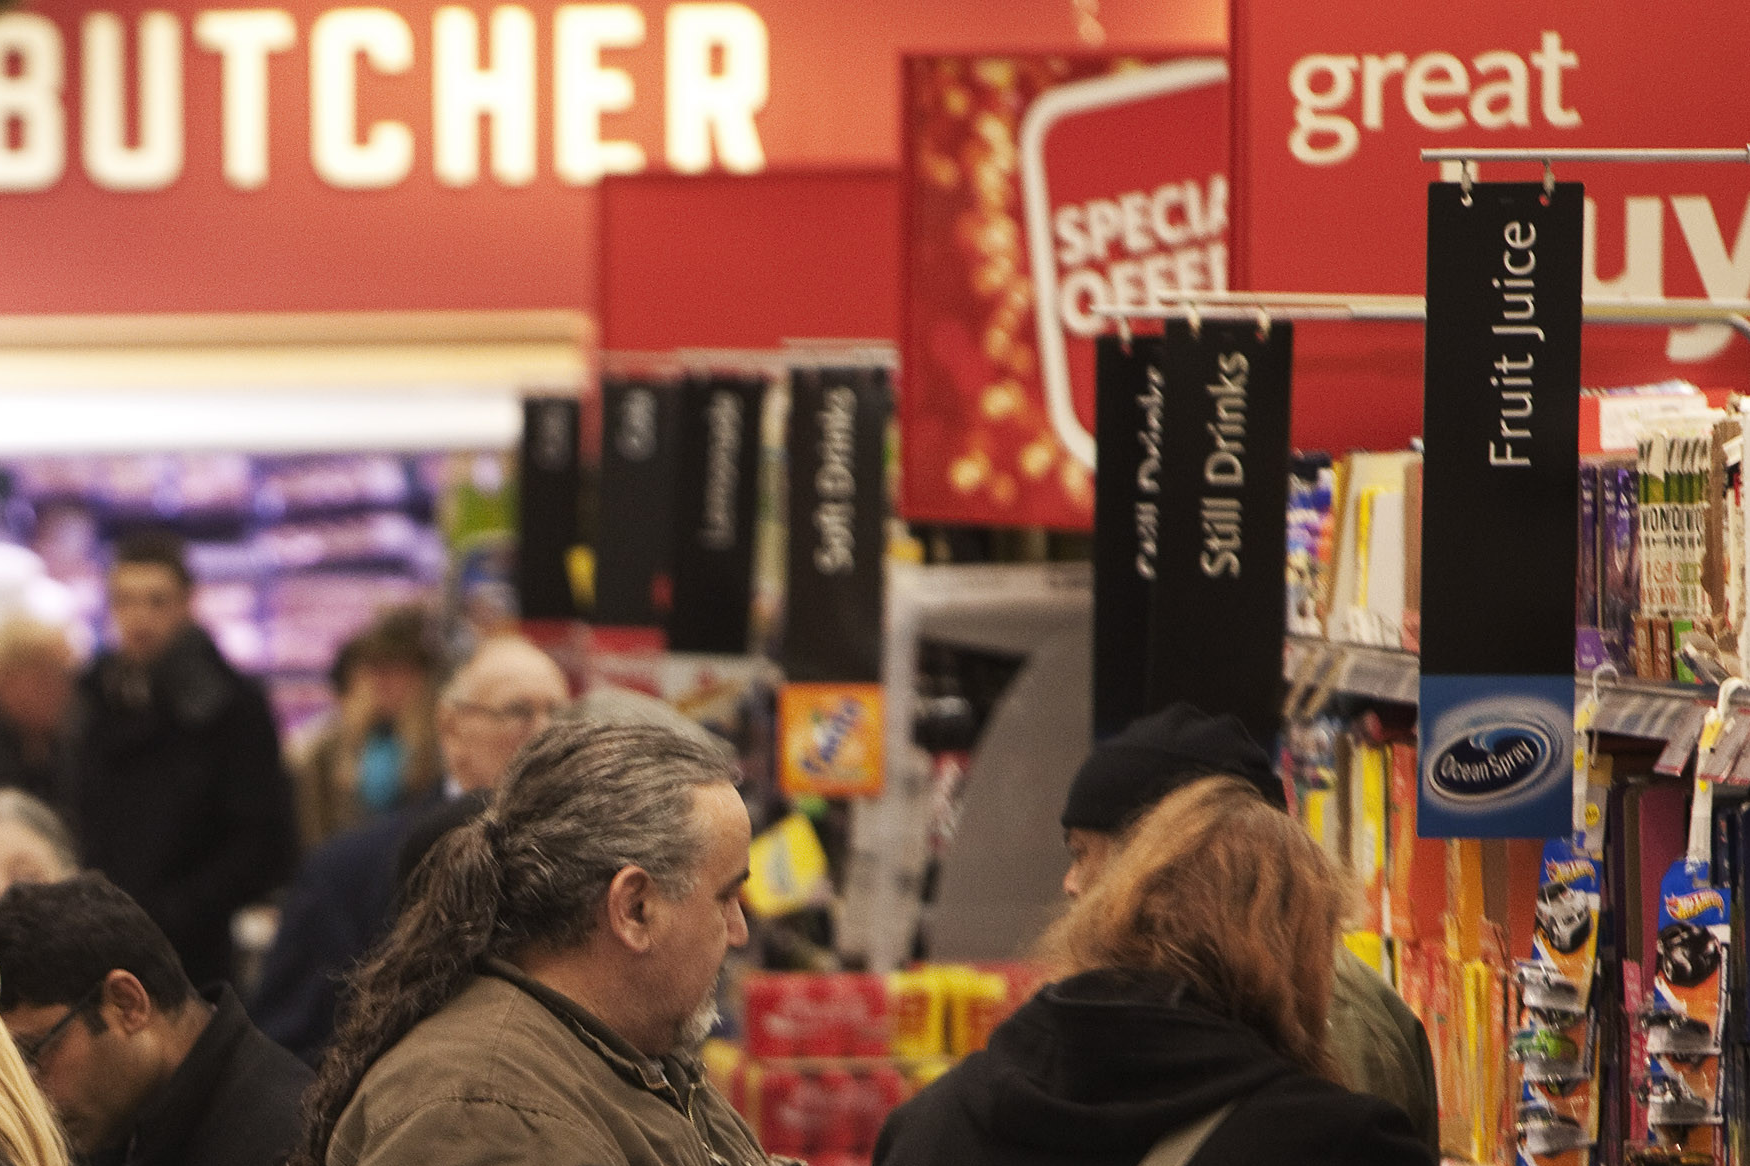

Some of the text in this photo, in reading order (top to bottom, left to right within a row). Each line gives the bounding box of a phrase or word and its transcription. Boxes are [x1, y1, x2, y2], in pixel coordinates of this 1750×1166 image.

[1289, 30, 1582, 166] great
[1063, 243, 1228, 337] OFFE
[1489, 221, 1546, 468] Fruit Juice
[815, 386, 857, 499] Drinks
[1199, 350, 1250, 578] Still Drinks
[1441, 740, 1536, 783] Ocean Spray
